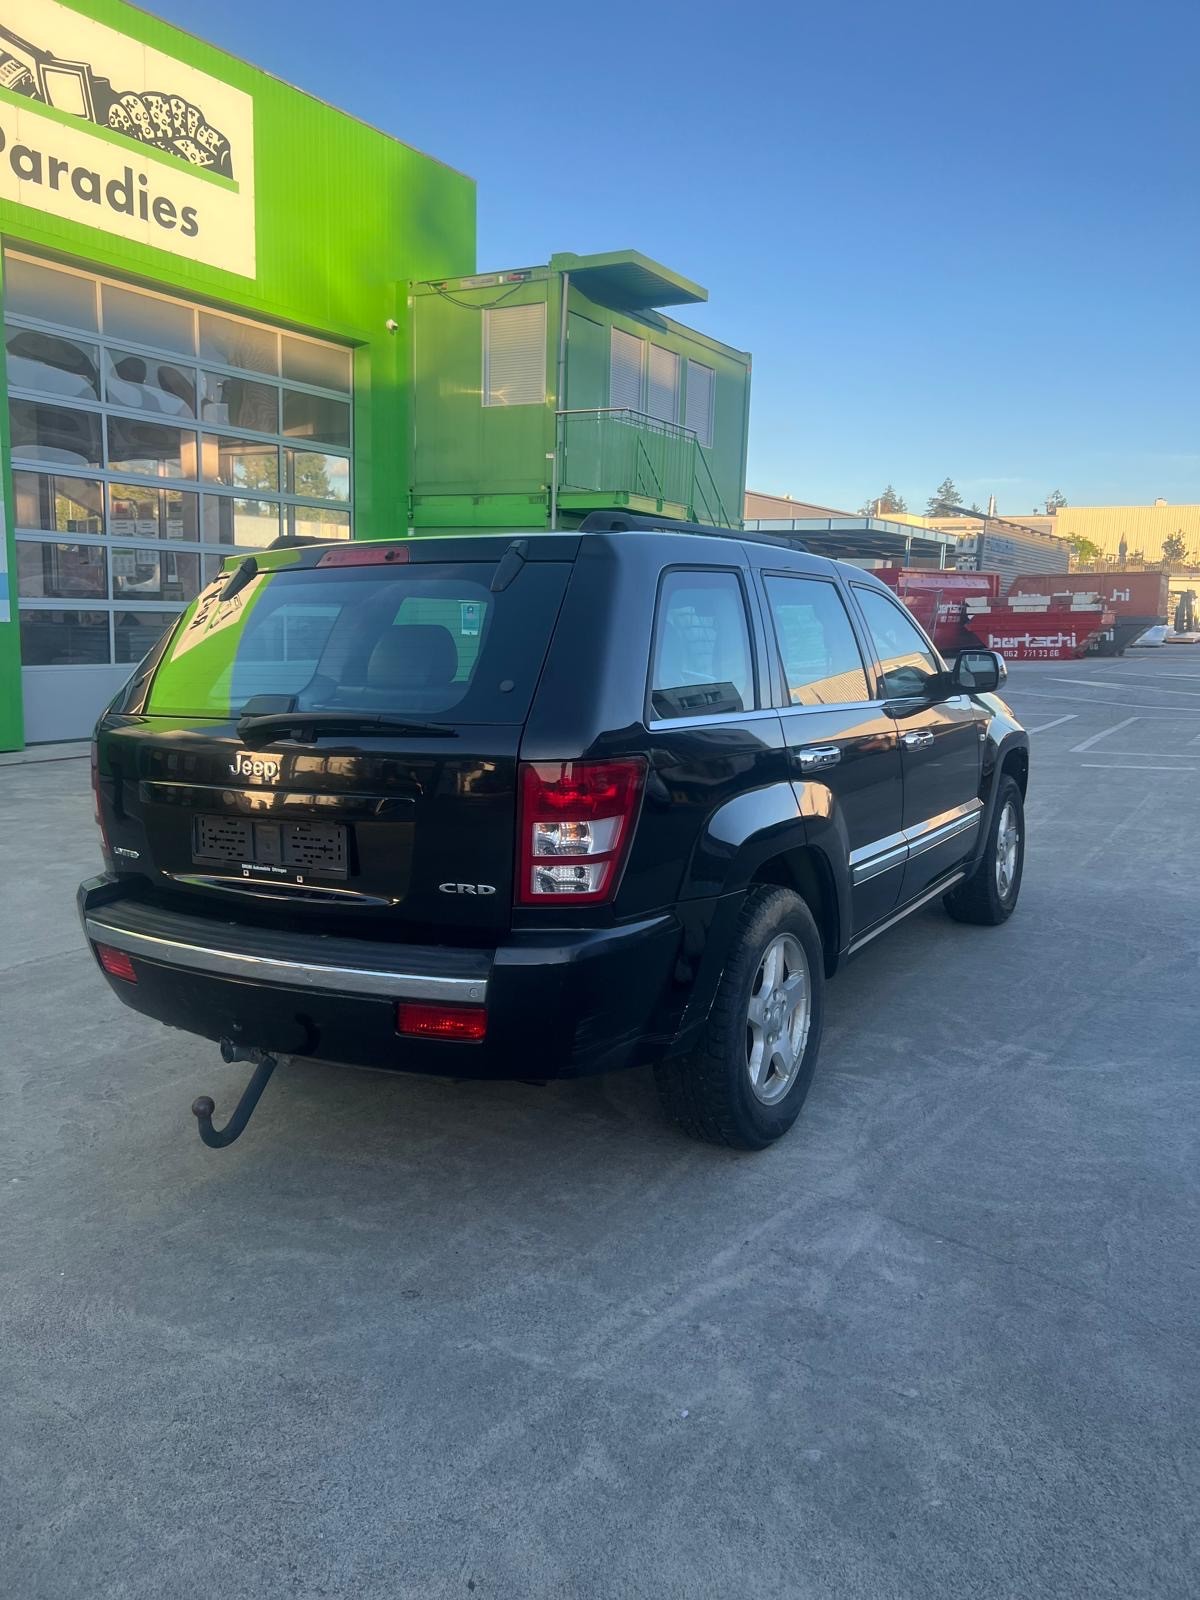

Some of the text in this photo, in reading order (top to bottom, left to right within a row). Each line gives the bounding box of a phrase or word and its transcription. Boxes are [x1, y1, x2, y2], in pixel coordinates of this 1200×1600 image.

[0, 125, 200, 238] aradies
[988, 631, 1077, 648] bertschi
[1003, 650, 1018, 658] 062
[1023, 649, 1036, 657] 771
[1038, 649, 1048, 657] 33
[228, 753, 278, 782] Jeep
[438, 882, 497, 895] CRD
